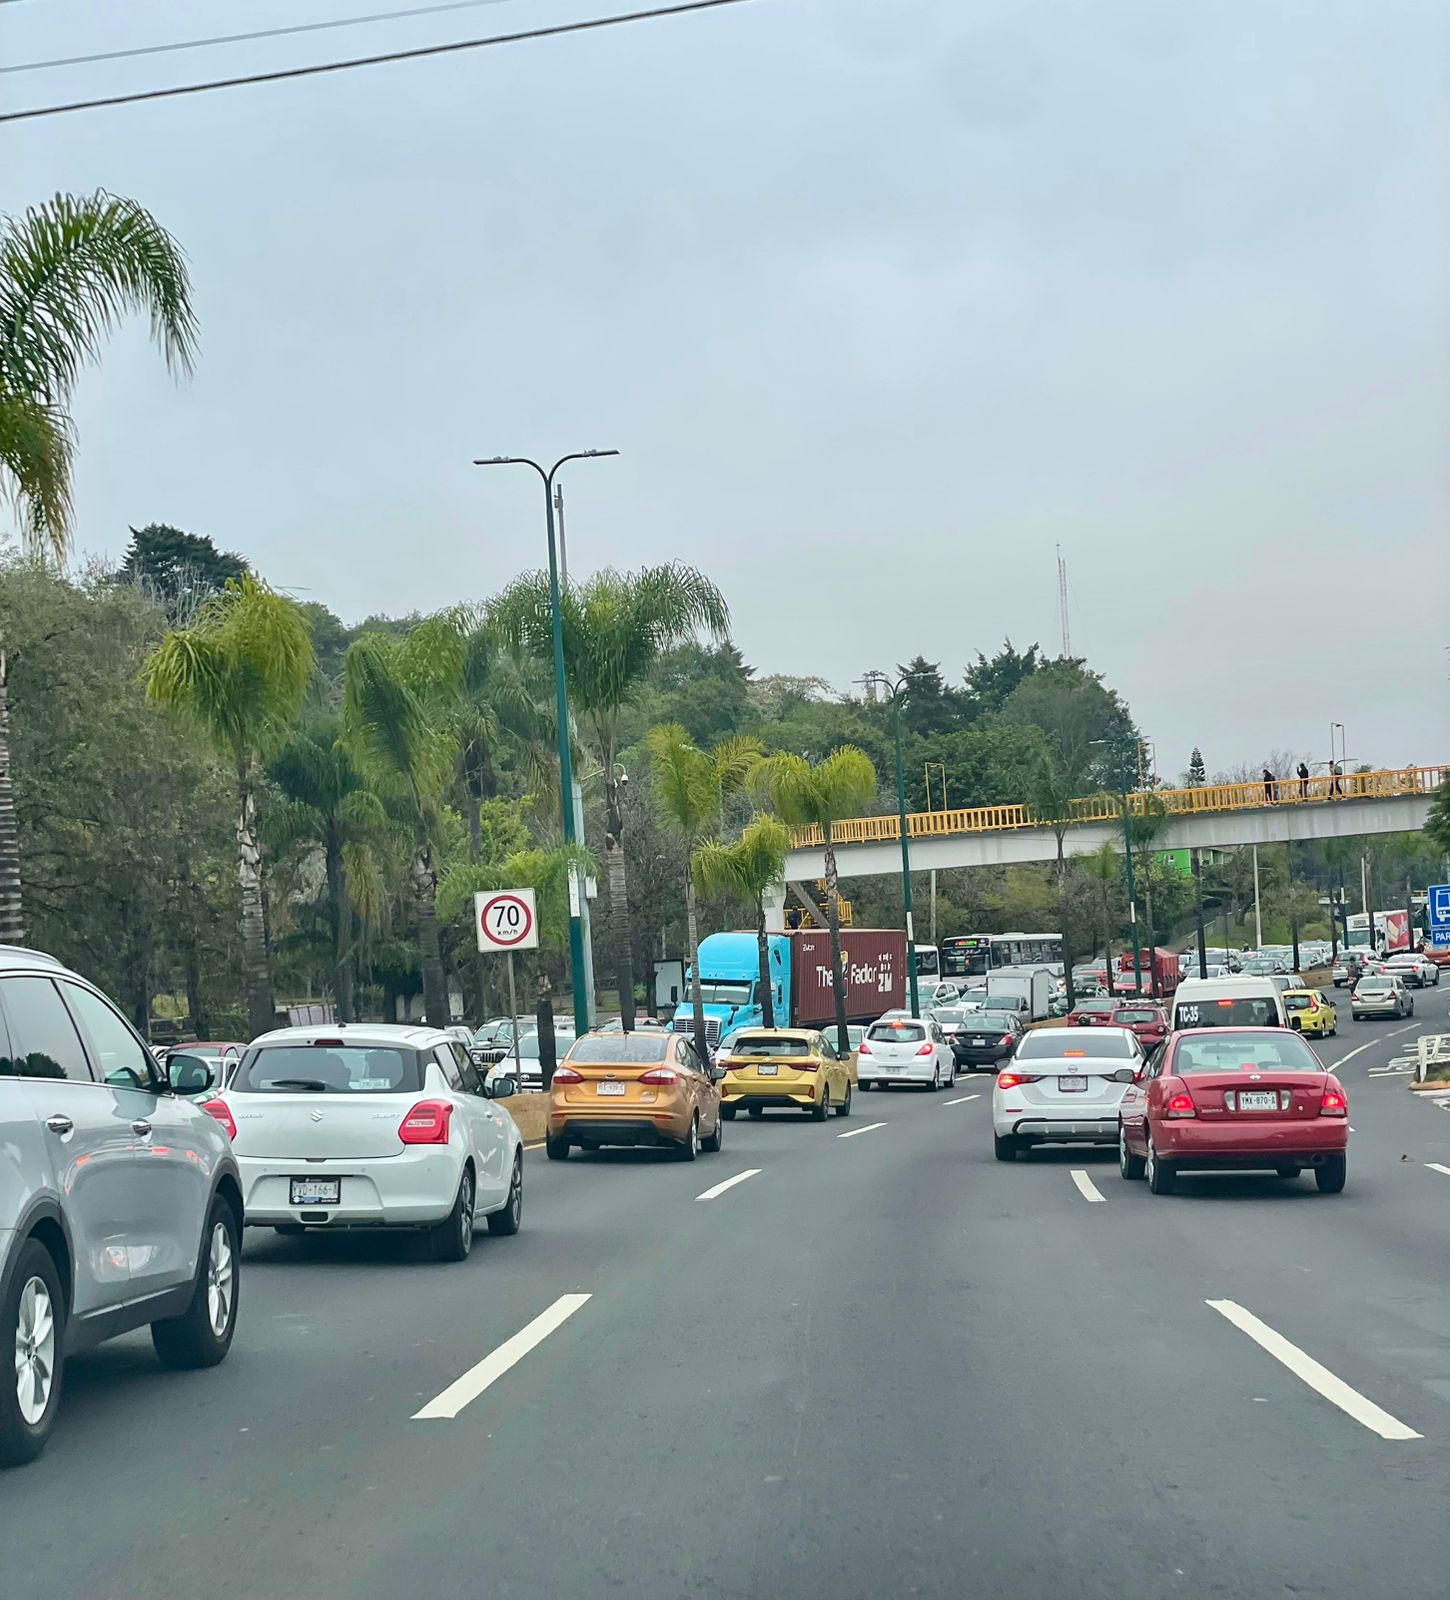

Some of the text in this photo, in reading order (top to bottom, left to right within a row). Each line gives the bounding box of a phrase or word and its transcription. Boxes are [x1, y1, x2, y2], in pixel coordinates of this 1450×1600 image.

[493, 905, 519, 928] 70
[497, 928, 518, 936] km/h
[816, 964, 833, 987] The
[1178, 1005, 1199, 1023] TC-35
